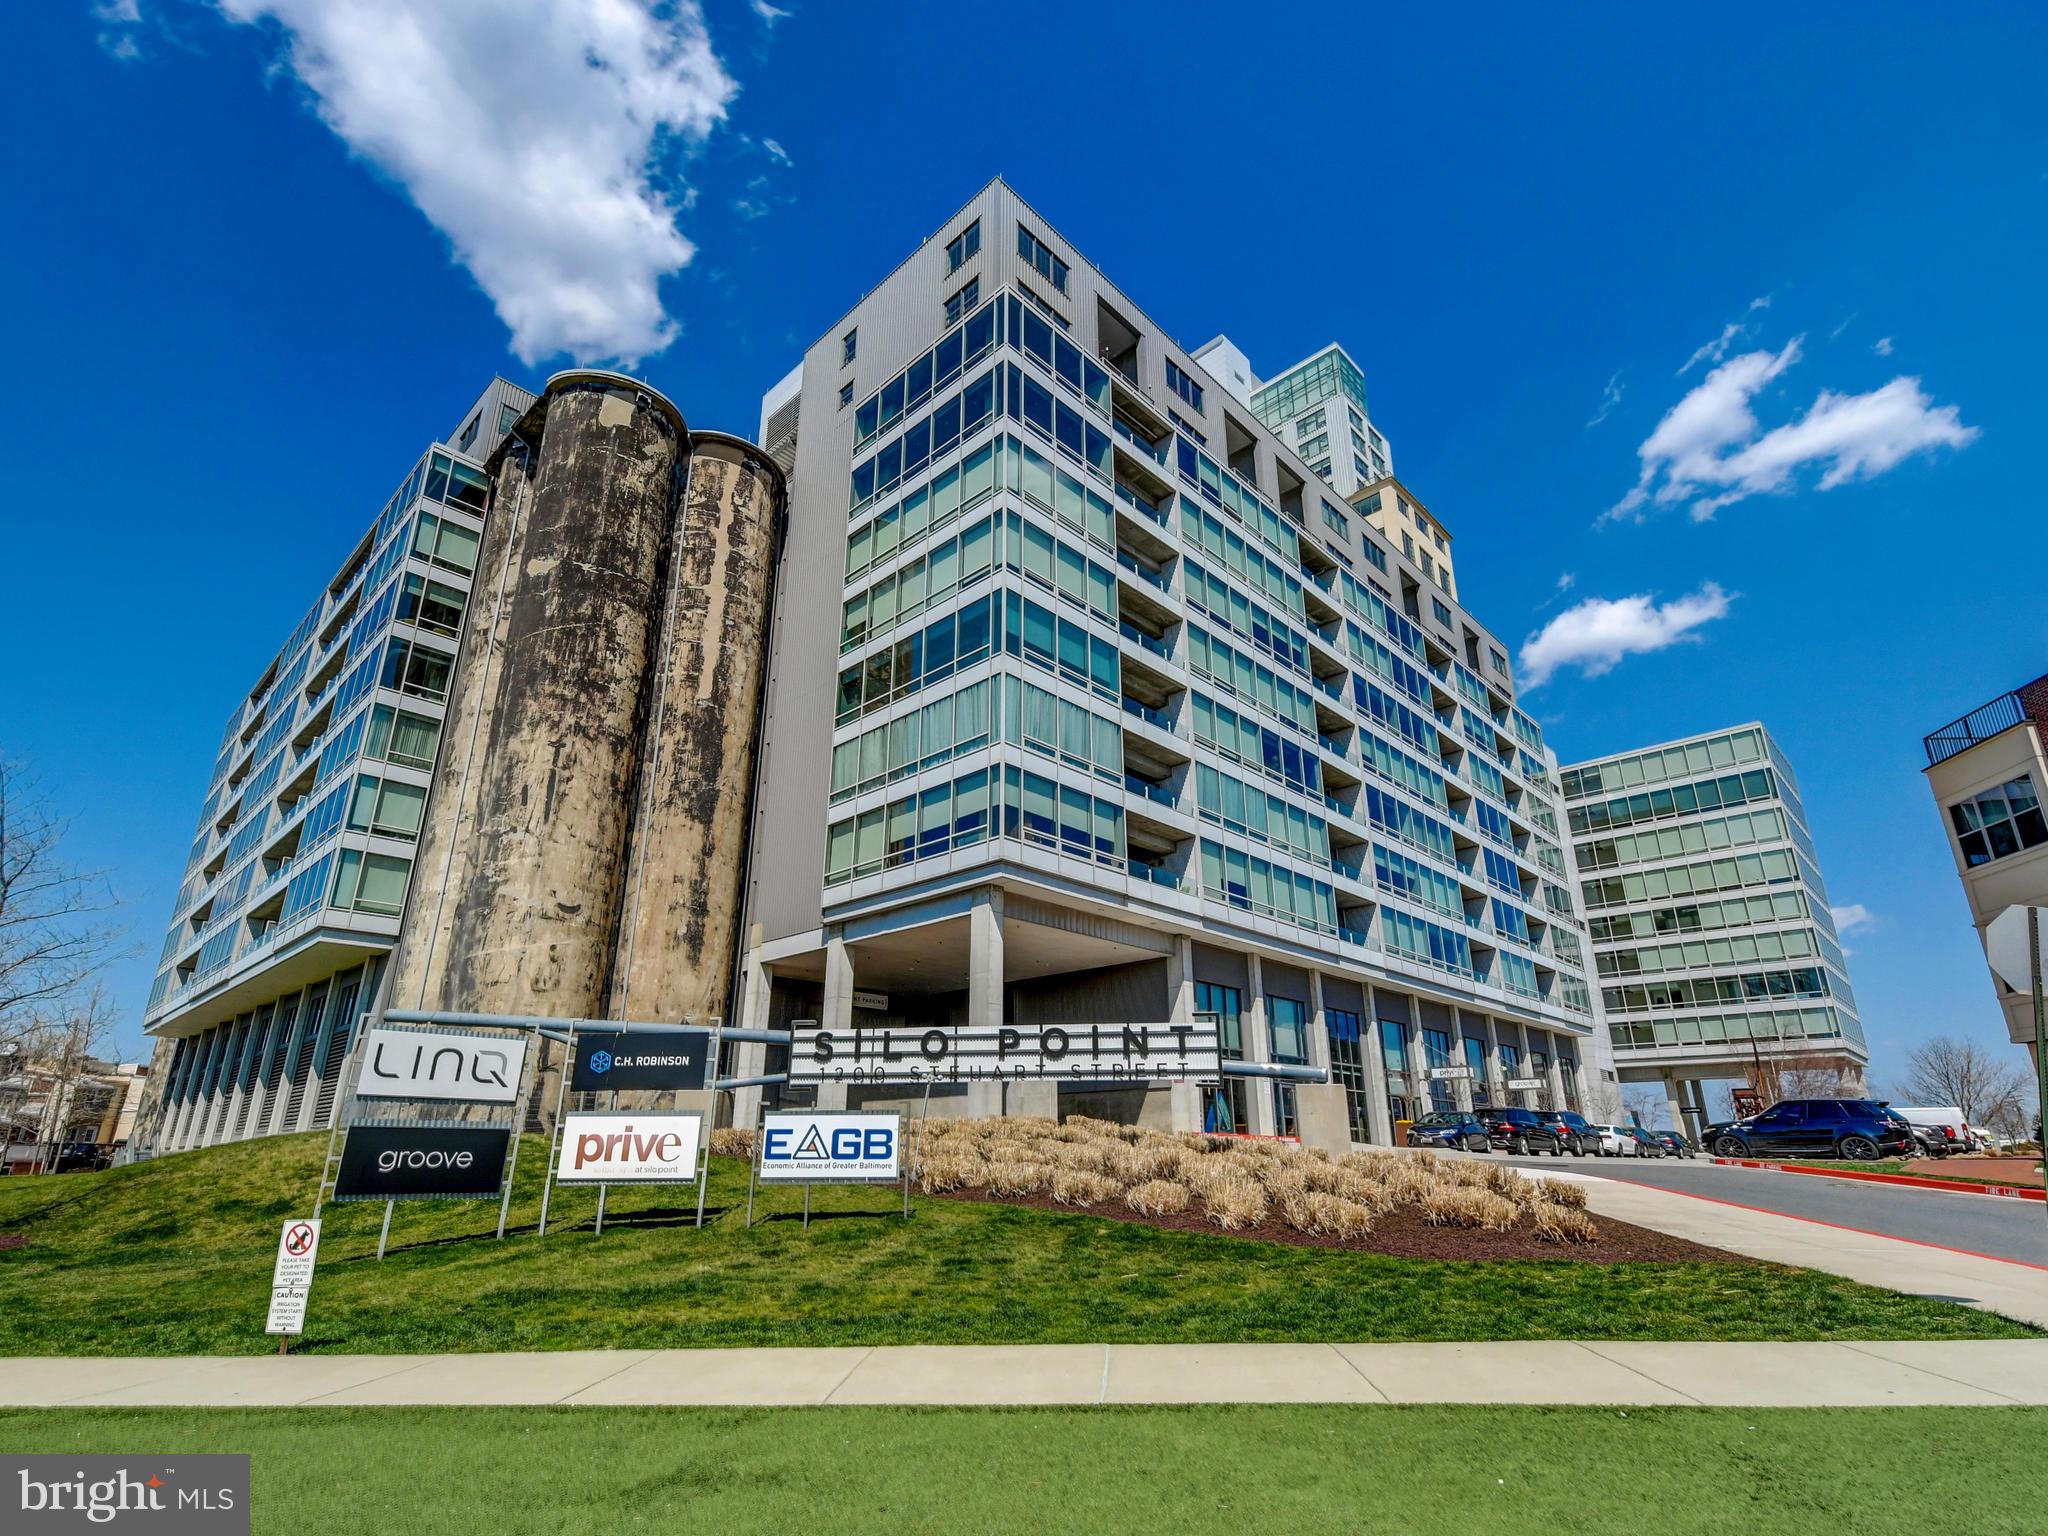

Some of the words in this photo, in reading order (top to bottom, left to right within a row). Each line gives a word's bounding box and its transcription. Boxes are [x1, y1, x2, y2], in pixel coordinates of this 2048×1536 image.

[614, 1056, 633, 1066] C.H.
[636, 1056, 690, 1066] ROBINSON
[814, 1029, 949, 1061] SILO
[998, 1025, 1193, 1060] POINT
[373, 1042, 508, 1088] LINQ
[819, 1066, 886, 1083] 1200
[1071, 1062, 1189, 1080] STREET
[574, 1125, 682, 1170] prive
[764, 1123, 893, 1160] EAGB
[378, 1149, 473, 1173] groove
